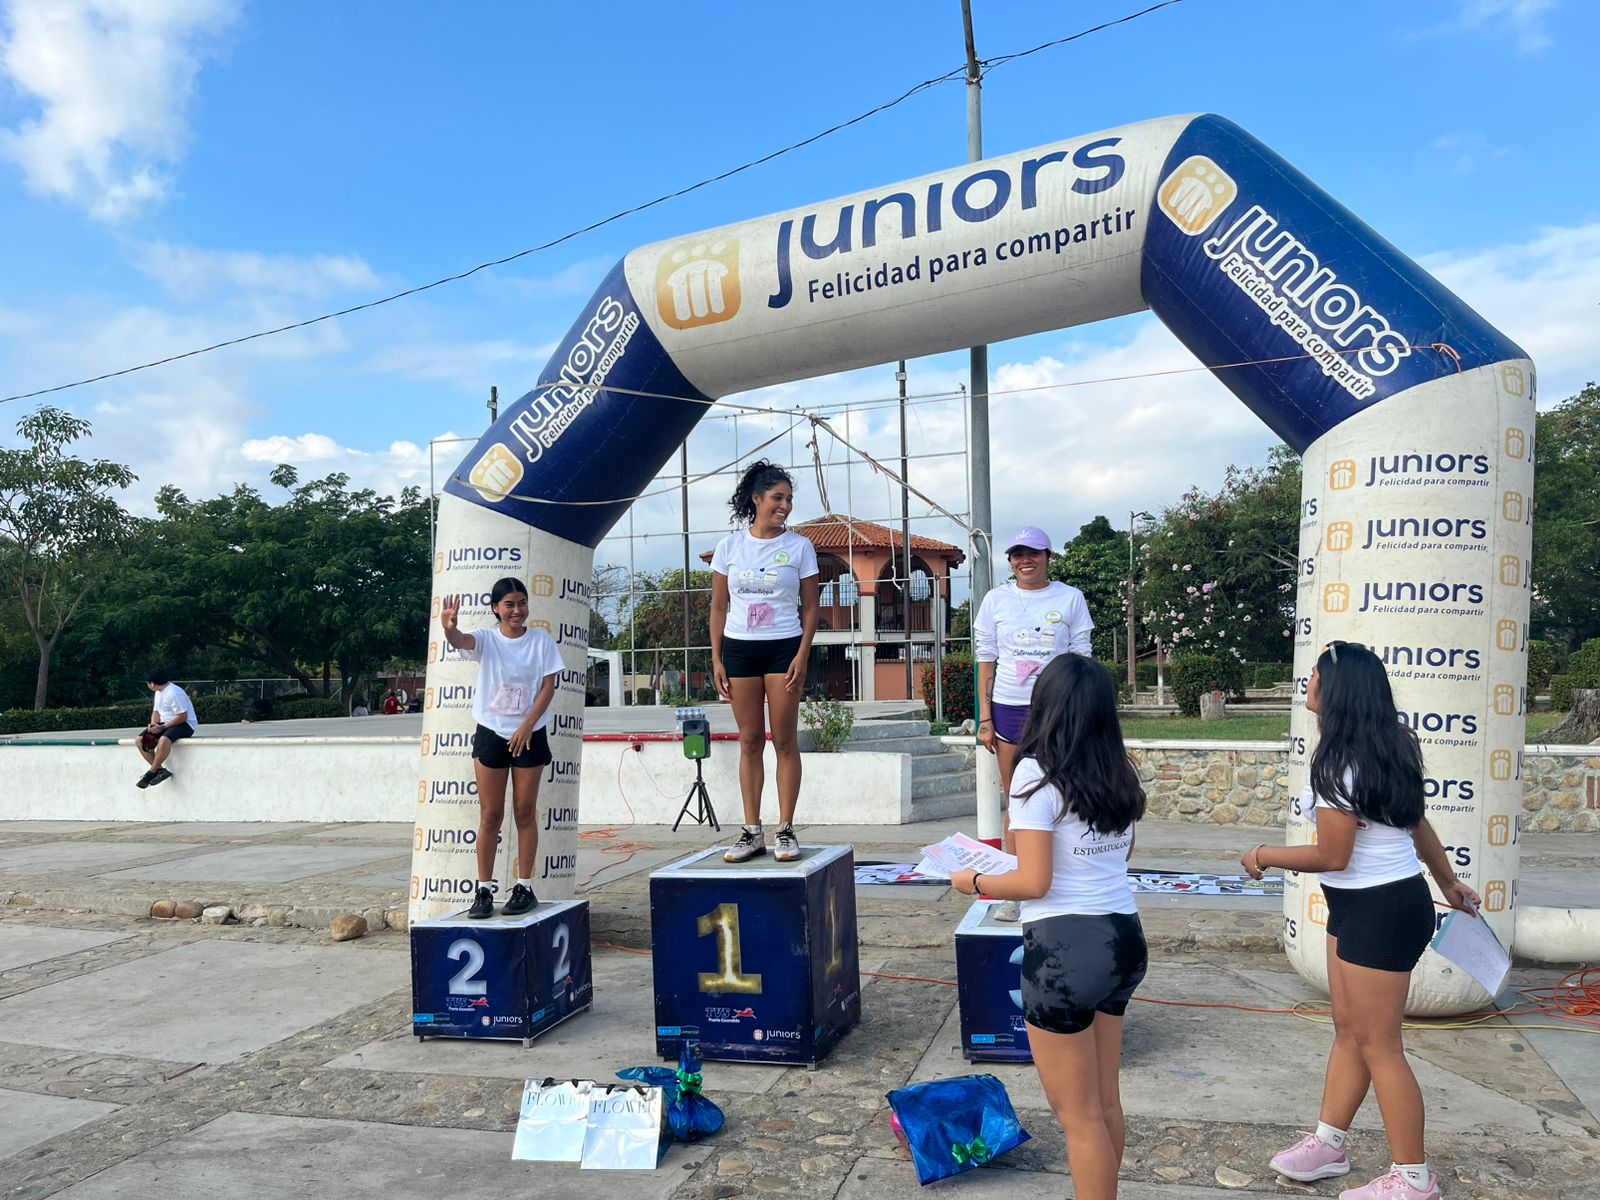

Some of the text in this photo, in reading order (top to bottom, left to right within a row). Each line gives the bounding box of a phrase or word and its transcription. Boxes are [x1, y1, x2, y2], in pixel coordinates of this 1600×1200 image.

[808, 208, 1136, 303] Felicidad para compartir
[1223, 256, 1372, 396] Felicidad para compartir
[542, 393, 584, 445] Felicidad
[600, 313, 638, 372] compartir
[1379, 478, 1422, 486] Felicidad
[1447, 479, 1490, 487] compartir
[1376, 541, 1487, 551] Felicidad para compartir
[1372, 605, 1484, 616] Felicidad para compartir
[1387, 670, 1481, 681] cidad para compartir
[1434, 738, 1478, 747] compartir
[1431, 804, 1475, 813] compartir
[552, 923, 570, 984] 2
[697, 903, 762, 994] 1
[447, 938, 487, 995] 2
[705, 1007, 730, 1018] TVS
